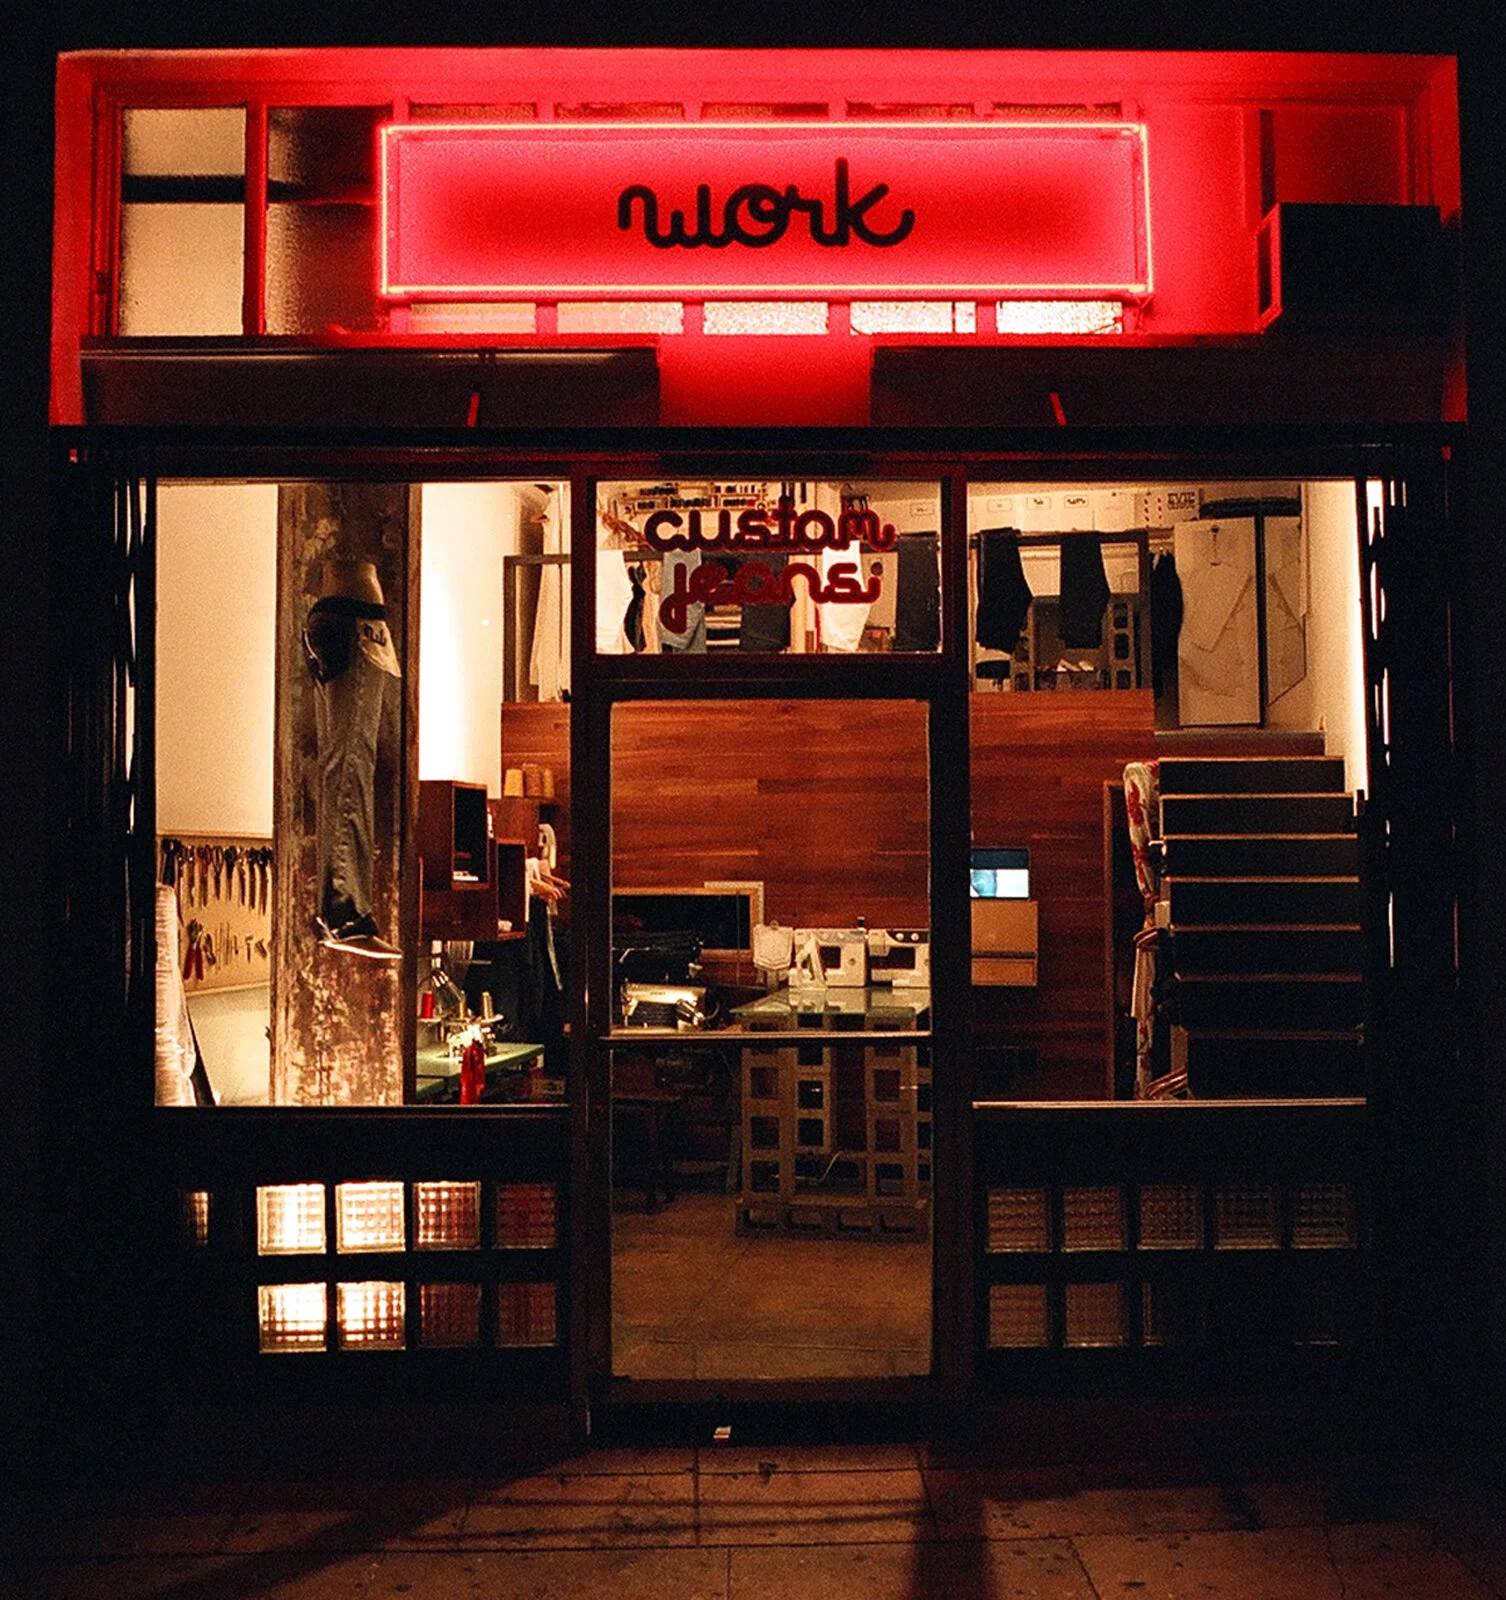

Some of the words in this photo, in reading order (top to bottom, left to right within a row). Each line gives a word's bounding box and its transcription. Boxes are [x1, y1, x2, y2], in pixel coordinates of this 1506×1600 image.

[618, 157, 915, 247] work
[644, 497, 896, 551] custom
[659, 562, 882, 634] jeans
